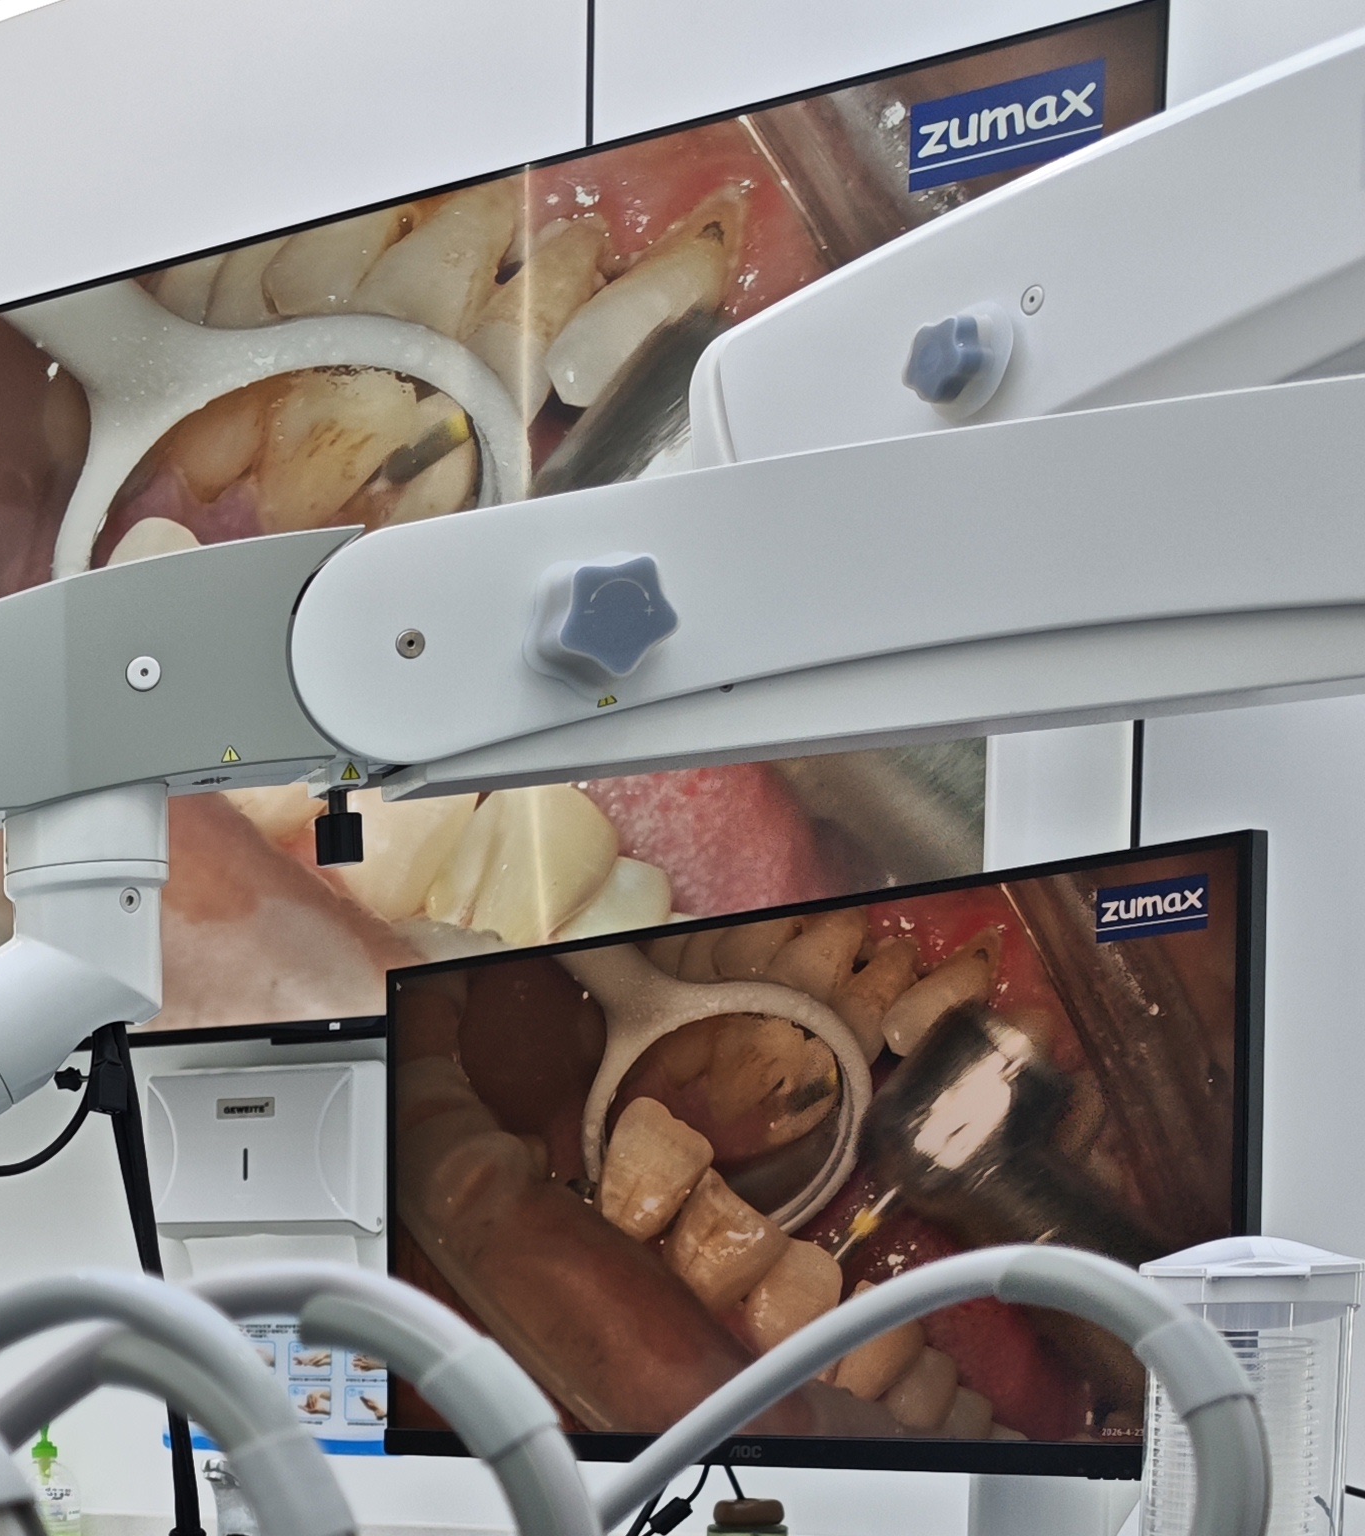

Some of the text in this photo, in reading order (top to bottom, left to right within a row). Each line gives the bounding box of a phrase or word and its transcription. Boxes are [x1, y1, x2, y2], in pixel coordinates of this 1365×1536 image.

[917, 81, 1098, 159] zumax
[1101, 887, 1204, 924] zumax
[729, 1445, 762, 1459] AOC
